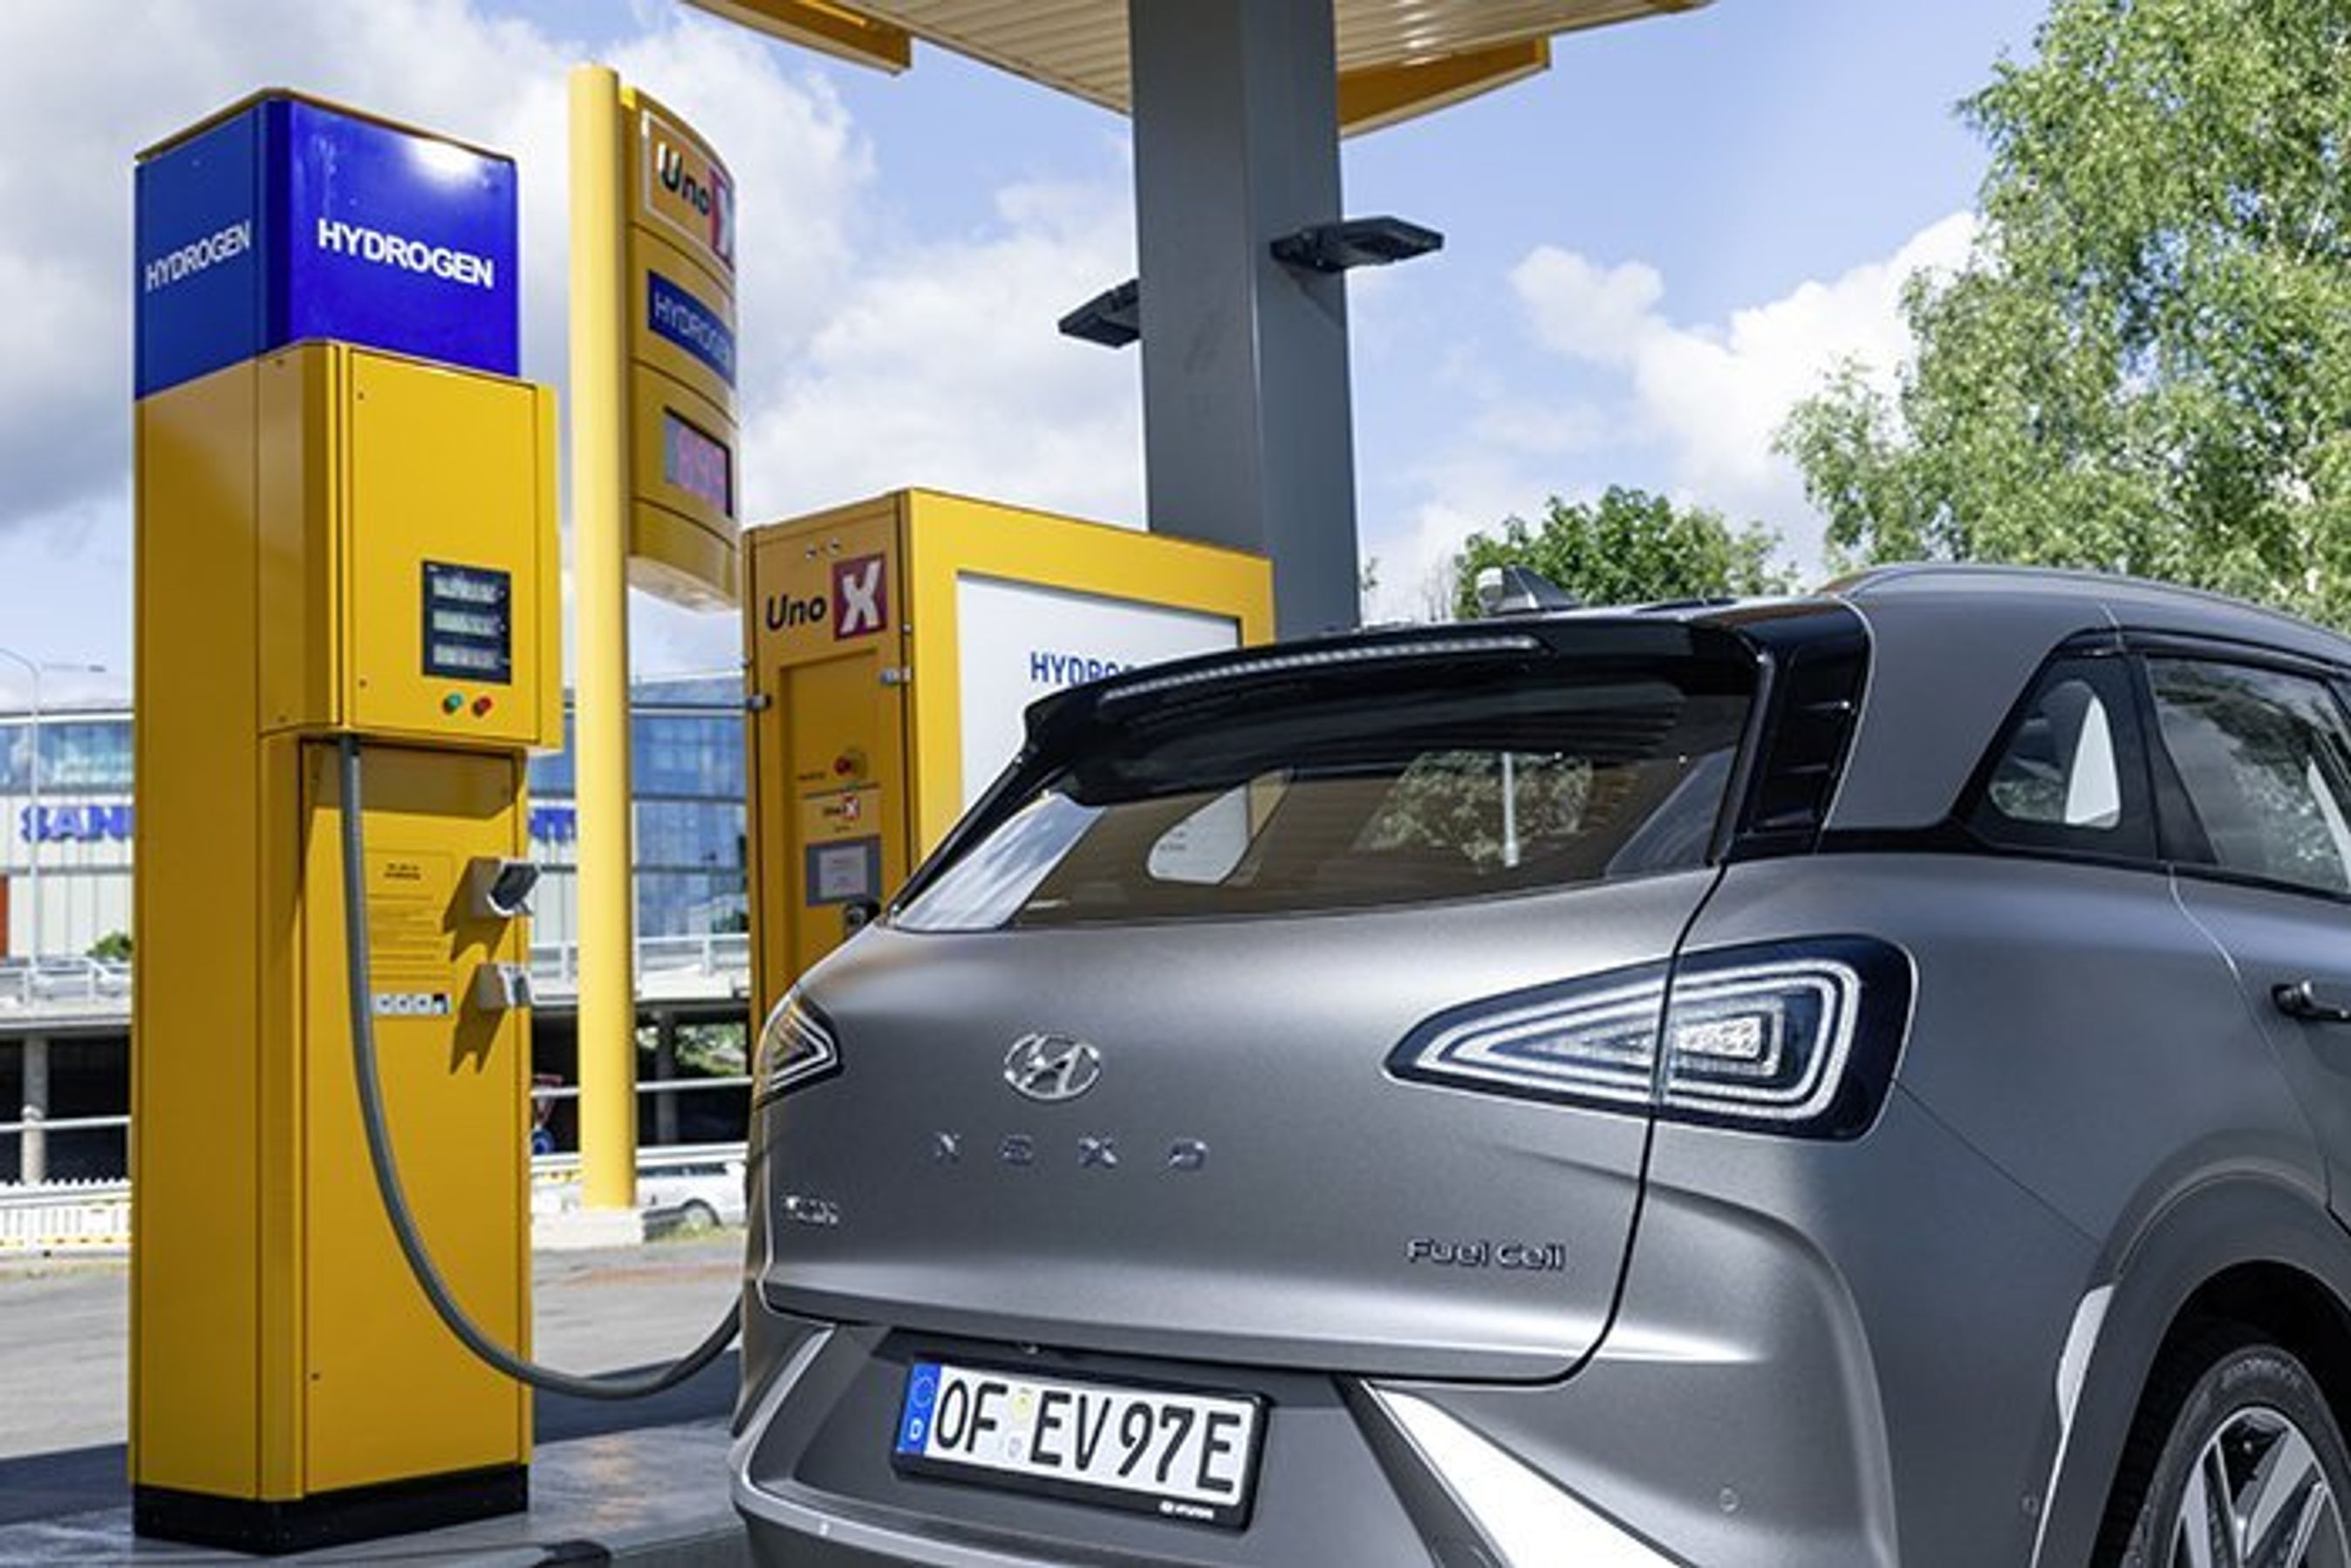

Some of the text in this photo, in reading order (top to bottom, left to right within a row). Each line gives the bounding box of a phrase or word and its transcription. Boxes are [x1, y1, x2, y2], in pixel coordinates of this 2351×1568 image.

[658, 142, 708, 215] Uno
[145, 221, 250, 292] HYDROGEN
[318, 218, 495, 290] HYDROGEN
[767, 594, 827, 631] Uno
[1030, 651, 1134, 685] HYDRO
[1407, 1238, 1567, 1271] Fuel Cell
[935, 1379, 1008, 1454] OF
